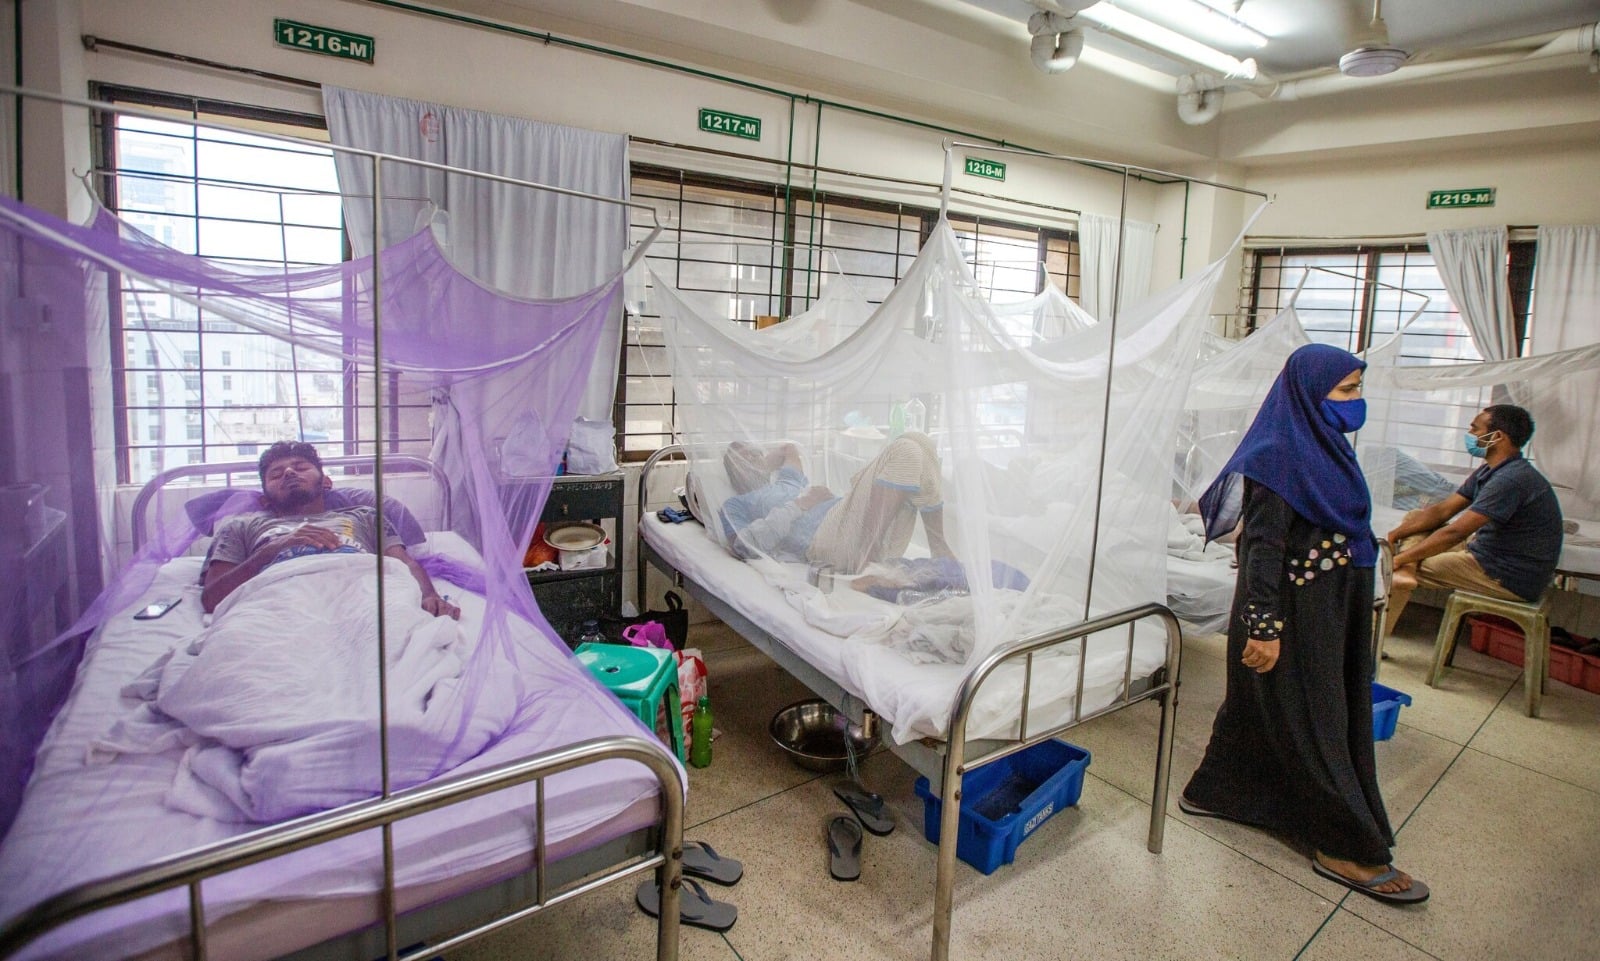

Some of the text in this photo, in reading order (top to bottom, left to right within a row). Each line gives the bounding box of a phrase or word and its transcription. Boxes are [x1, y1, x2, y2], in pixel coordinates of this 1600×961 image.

[283, 27, 367, 58] 1216-M
[704, 114, 756, 135] 1217-M
[967, 161, 1003, 178] 1218-M
[1432, 193, 1489, 205] 1219-M
